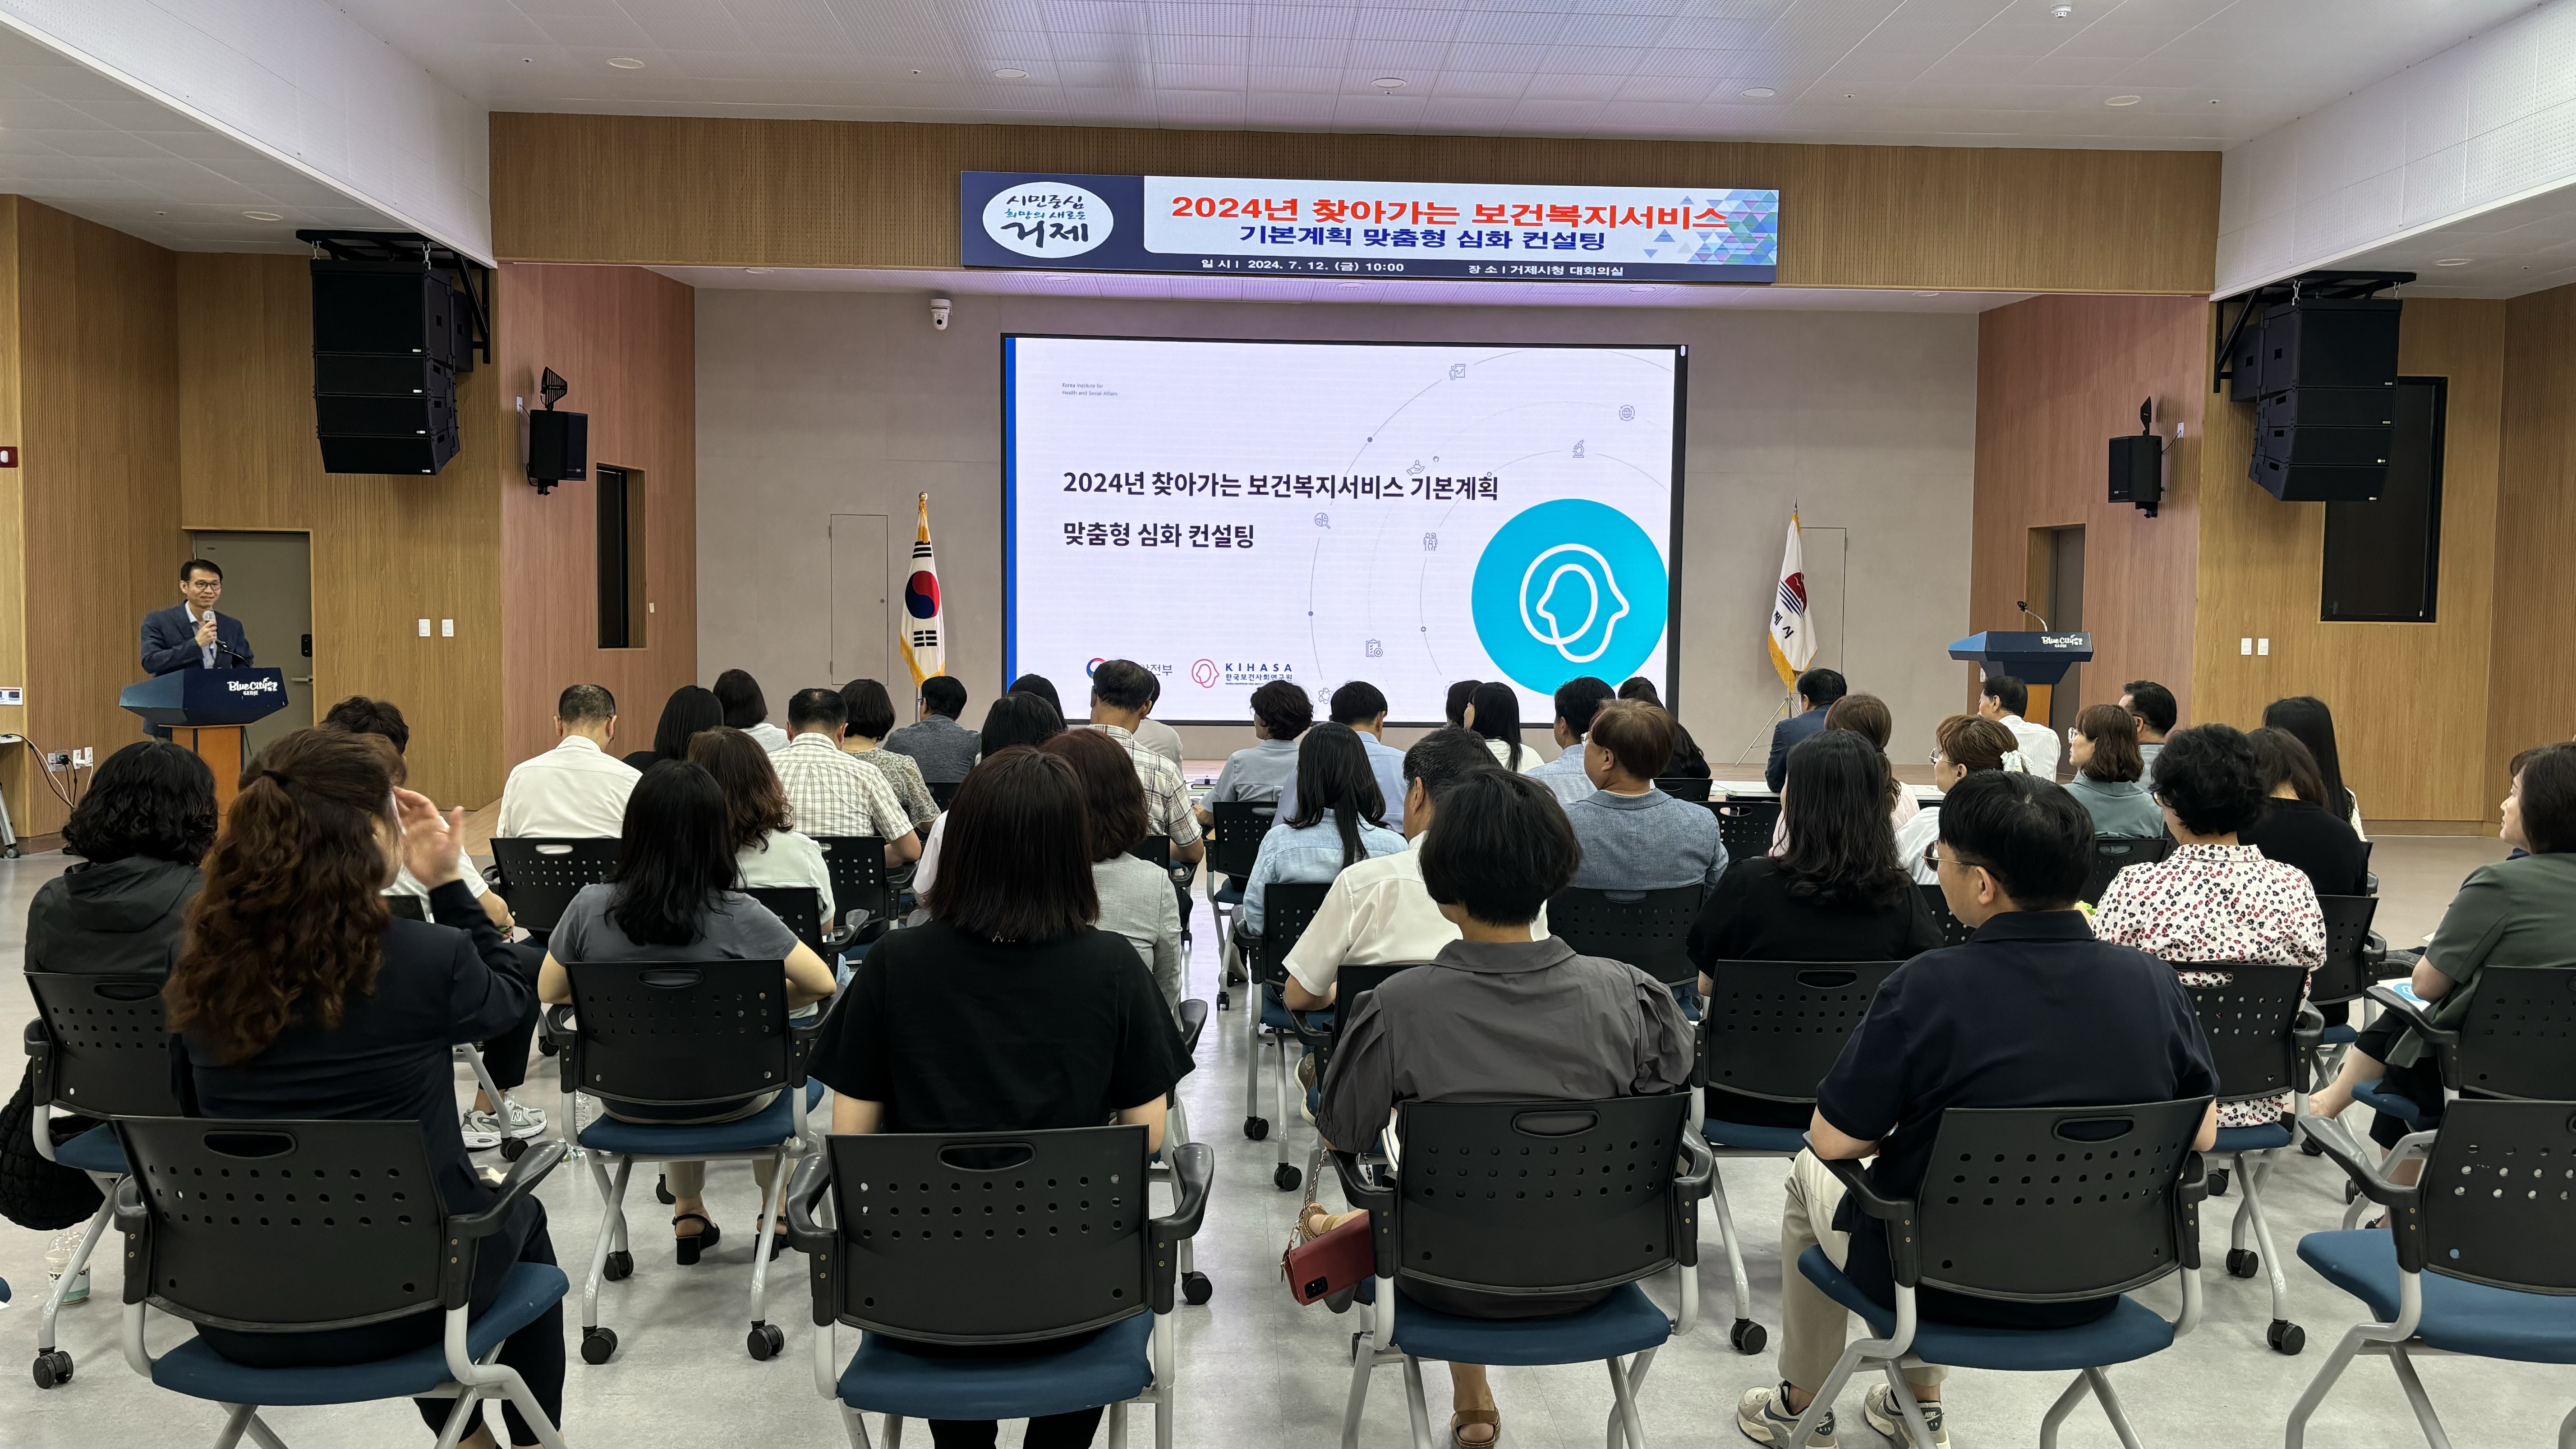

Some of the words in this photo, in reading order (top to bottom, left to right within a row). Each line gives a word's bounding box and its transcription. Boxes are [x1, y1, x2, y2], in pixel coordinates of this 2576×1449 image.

[1006, 195, 1085, 209] 시민중심
[1005, 208, 1045, 219] 희망의
[1049, 211, 1086, 220] 새로운
[1172, 196, 1298, 222] 2024년
[1312, 199, 1460, 225] 찾아가는
[1472, 203, 1730, 230] 보건복지서비스
[1000, 220, 1089, 248] 거제
[1240, 225, 1352, 246] 기본계획
[1363, 228, 1446, 248] 맞춤형
[1456, 230, 1513, 250] 심화
[1522, 231, 1605, 251] 컨설팅
[1248, 260, 1283, 269] 2024.
[1288, 261, 1302, 269] 7.
[1308, 262, 1329, 270] 12.
[1335, 262, 1359, 271] (금)
[1366, 263, 1404, 272] 10:00
[1510, 265, 1564, 276] 거제시청
[1570, 266, 1624, 276] 대회의실
[1063, 471, 1145, 496] 2024년
[1152, 472, 1242, 497] 찾아가는
[1247, 474, 1404, 499] 보건복지서비스
[1410, 475, 1498, 501] 기본계획
[1064, 522, 1130, 547] 맞춤형
[1137, 523, 1182, 547] 심화
[1189, 524, 1254, 548] 컨설팅
[1225, 663, 1292, 672] KIHASA
[1225, 673, 1293, 681] 한국보건사회연구원
